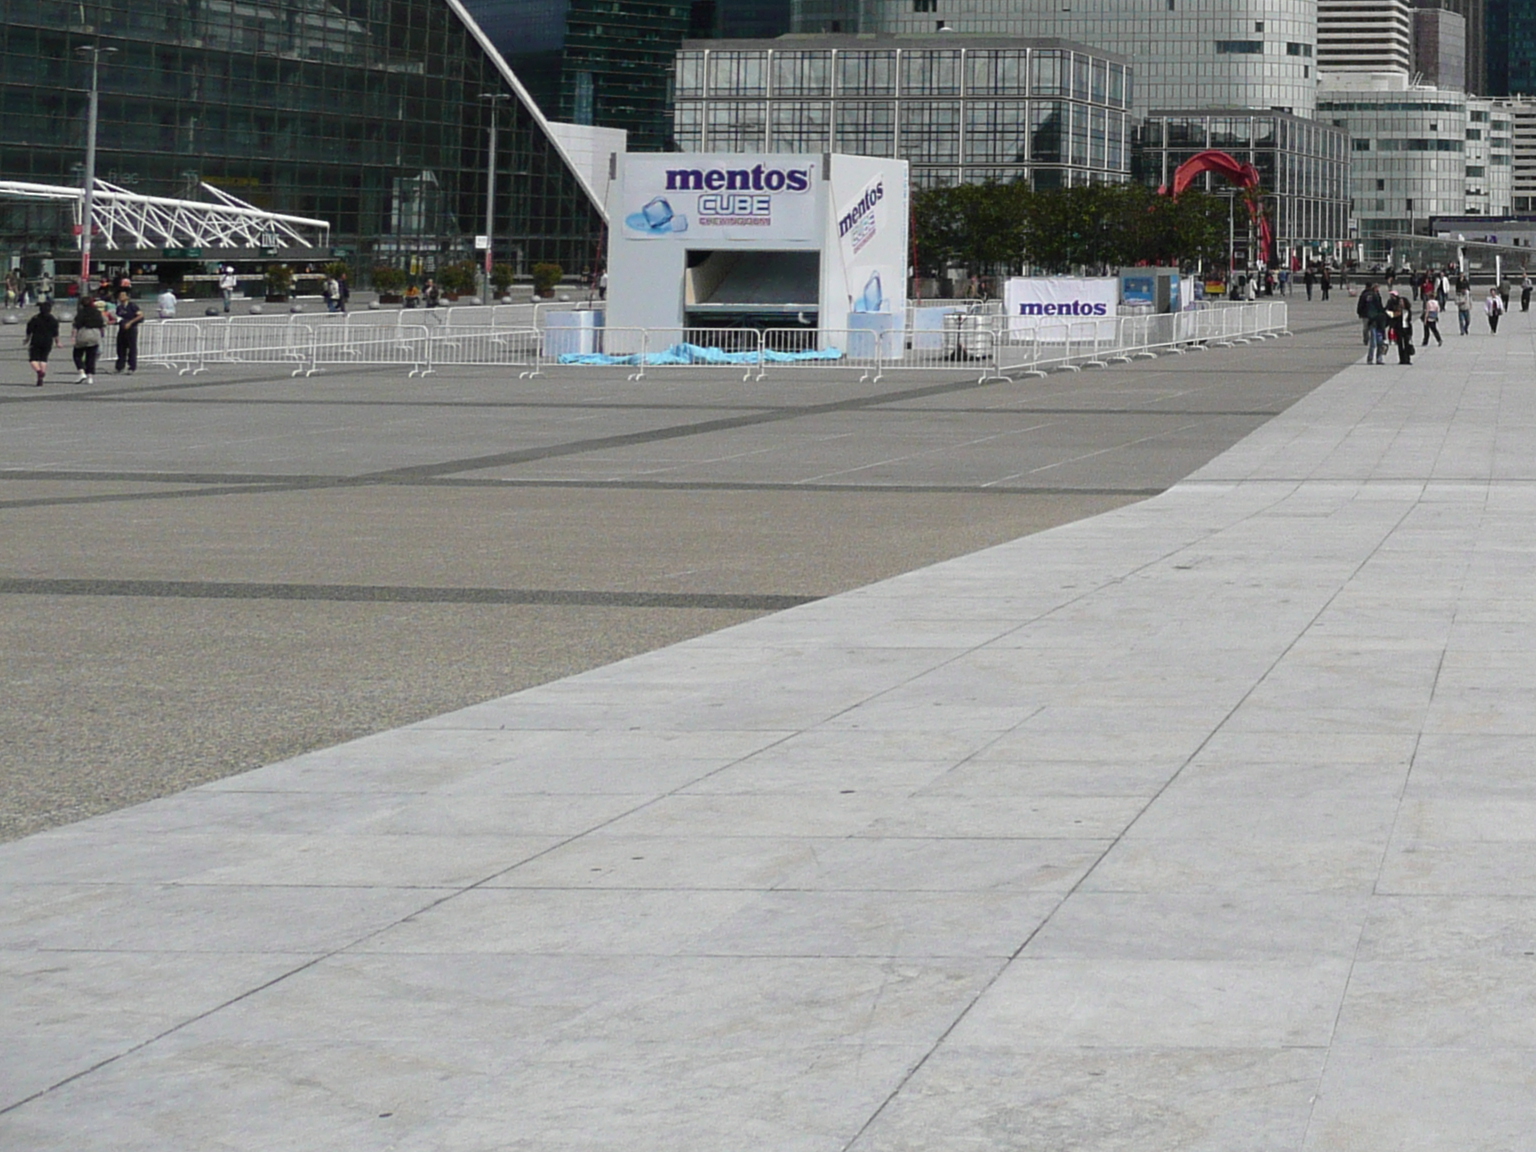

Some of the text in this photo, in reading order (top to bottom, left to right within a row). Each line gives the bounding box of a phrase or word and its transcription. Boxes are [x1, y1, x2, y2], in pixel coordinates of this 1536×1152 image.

[665, 163, 808, 191] mentos
[698, 193, 771, 216] CUBE
[838, 181, 884, 239] mentos
[1019, 299, 1107, 316] mentos
